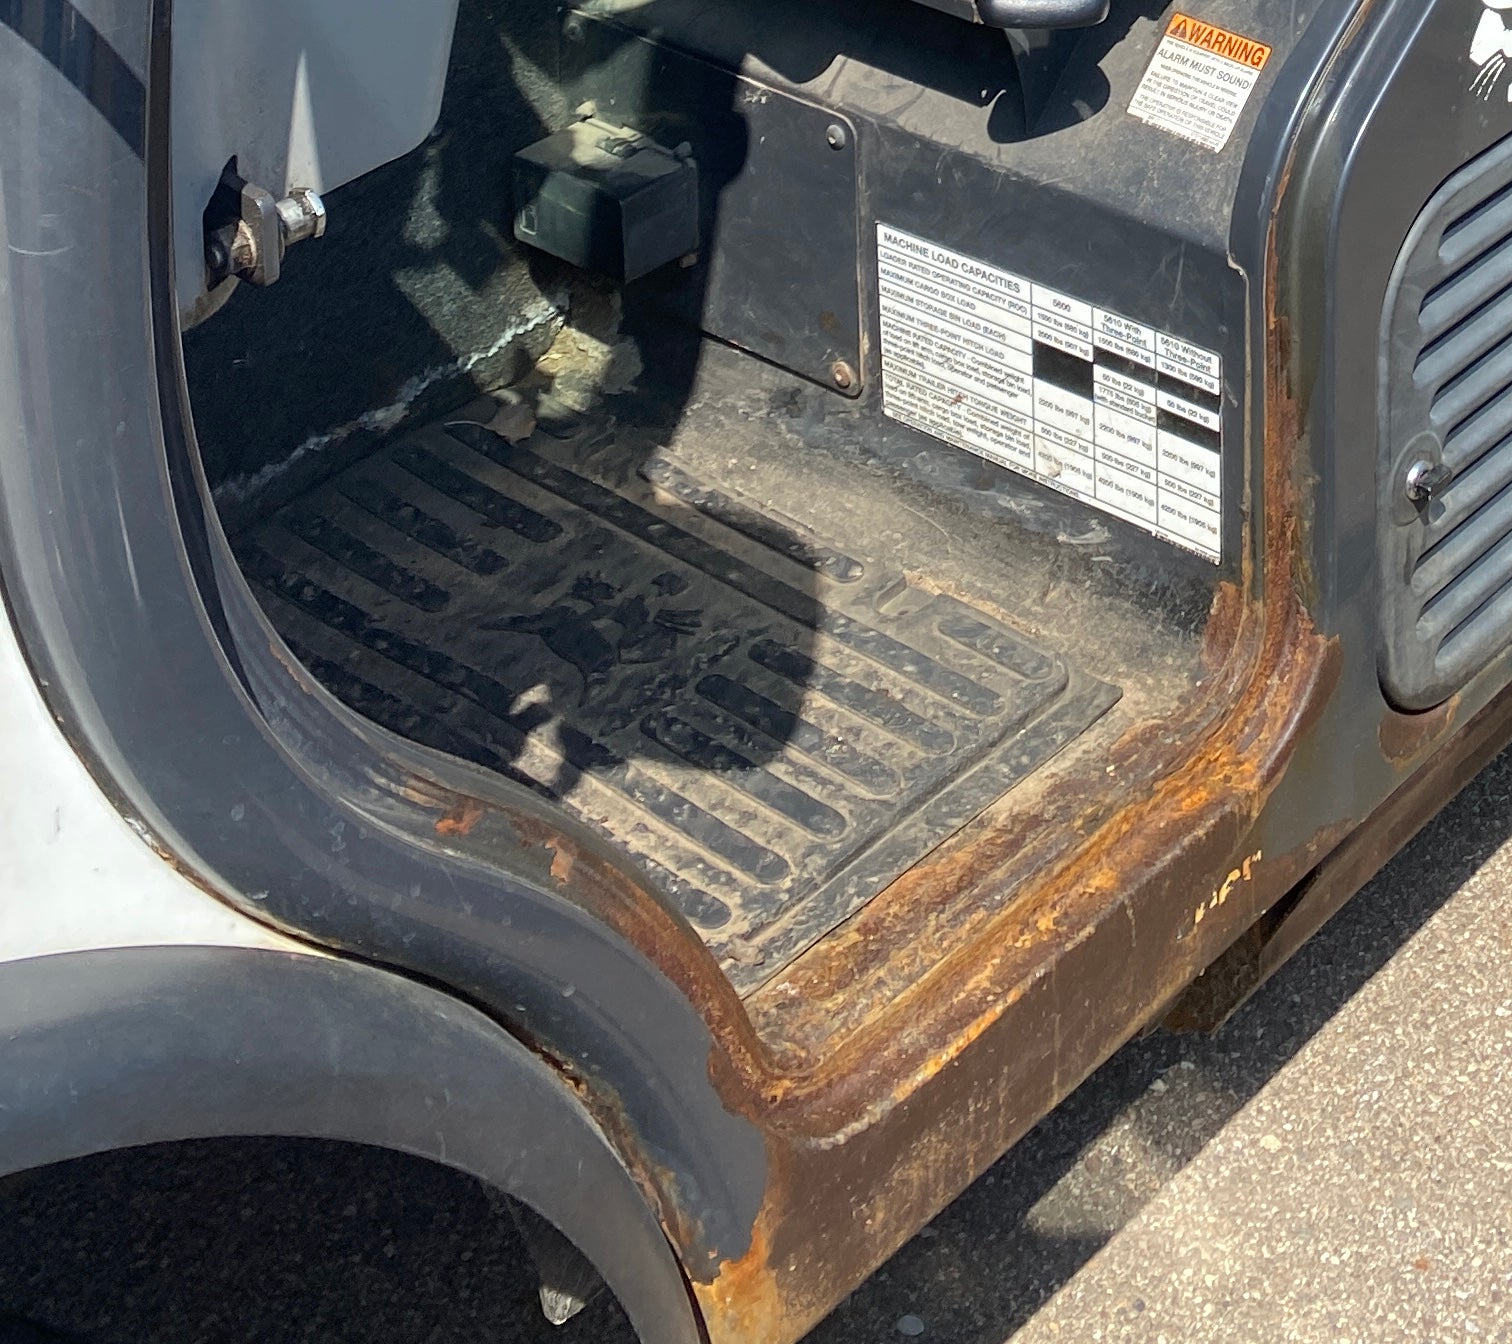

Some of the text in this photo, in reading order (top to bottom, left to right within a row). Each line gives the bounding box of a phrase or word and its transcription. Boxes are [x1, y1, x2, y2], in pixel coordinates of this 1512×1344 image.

[1186, 22, 1265, 67] WARNING
[1156, 46, 1190, 67] ALARM
[1188, 59, 1216, 77] MUST
[1216, 69, 1252, 91] SOUND!
[880, 249, 906, 267] LOADER
[908, 260, 930, 276] RATED
[932, 270, 970, 292] OPERATING
[972, 286, 1006, 306] CAPACITY
[884, 231, 1020, 294] MACHINE LOAD CAPACITIES
[881, 266, 975, 311] MAXIMUM CARGO BOX LOAD
[881, 284, 913, 304] MAXIMUM
[915, 298, 947, 317] STORAGE
[948, 311, 960, 323] BIN
[962, 317, 980, 331] LOAD
[882, 303, 1004, 360] MAXIMUM THREE-POINT HITCH LOAD
[1101, 322, 1146, 347] Three-Point
[1161, 336, 1211, 363] 5610 Without
[1165, 347, 1210, 372] Three-Point
